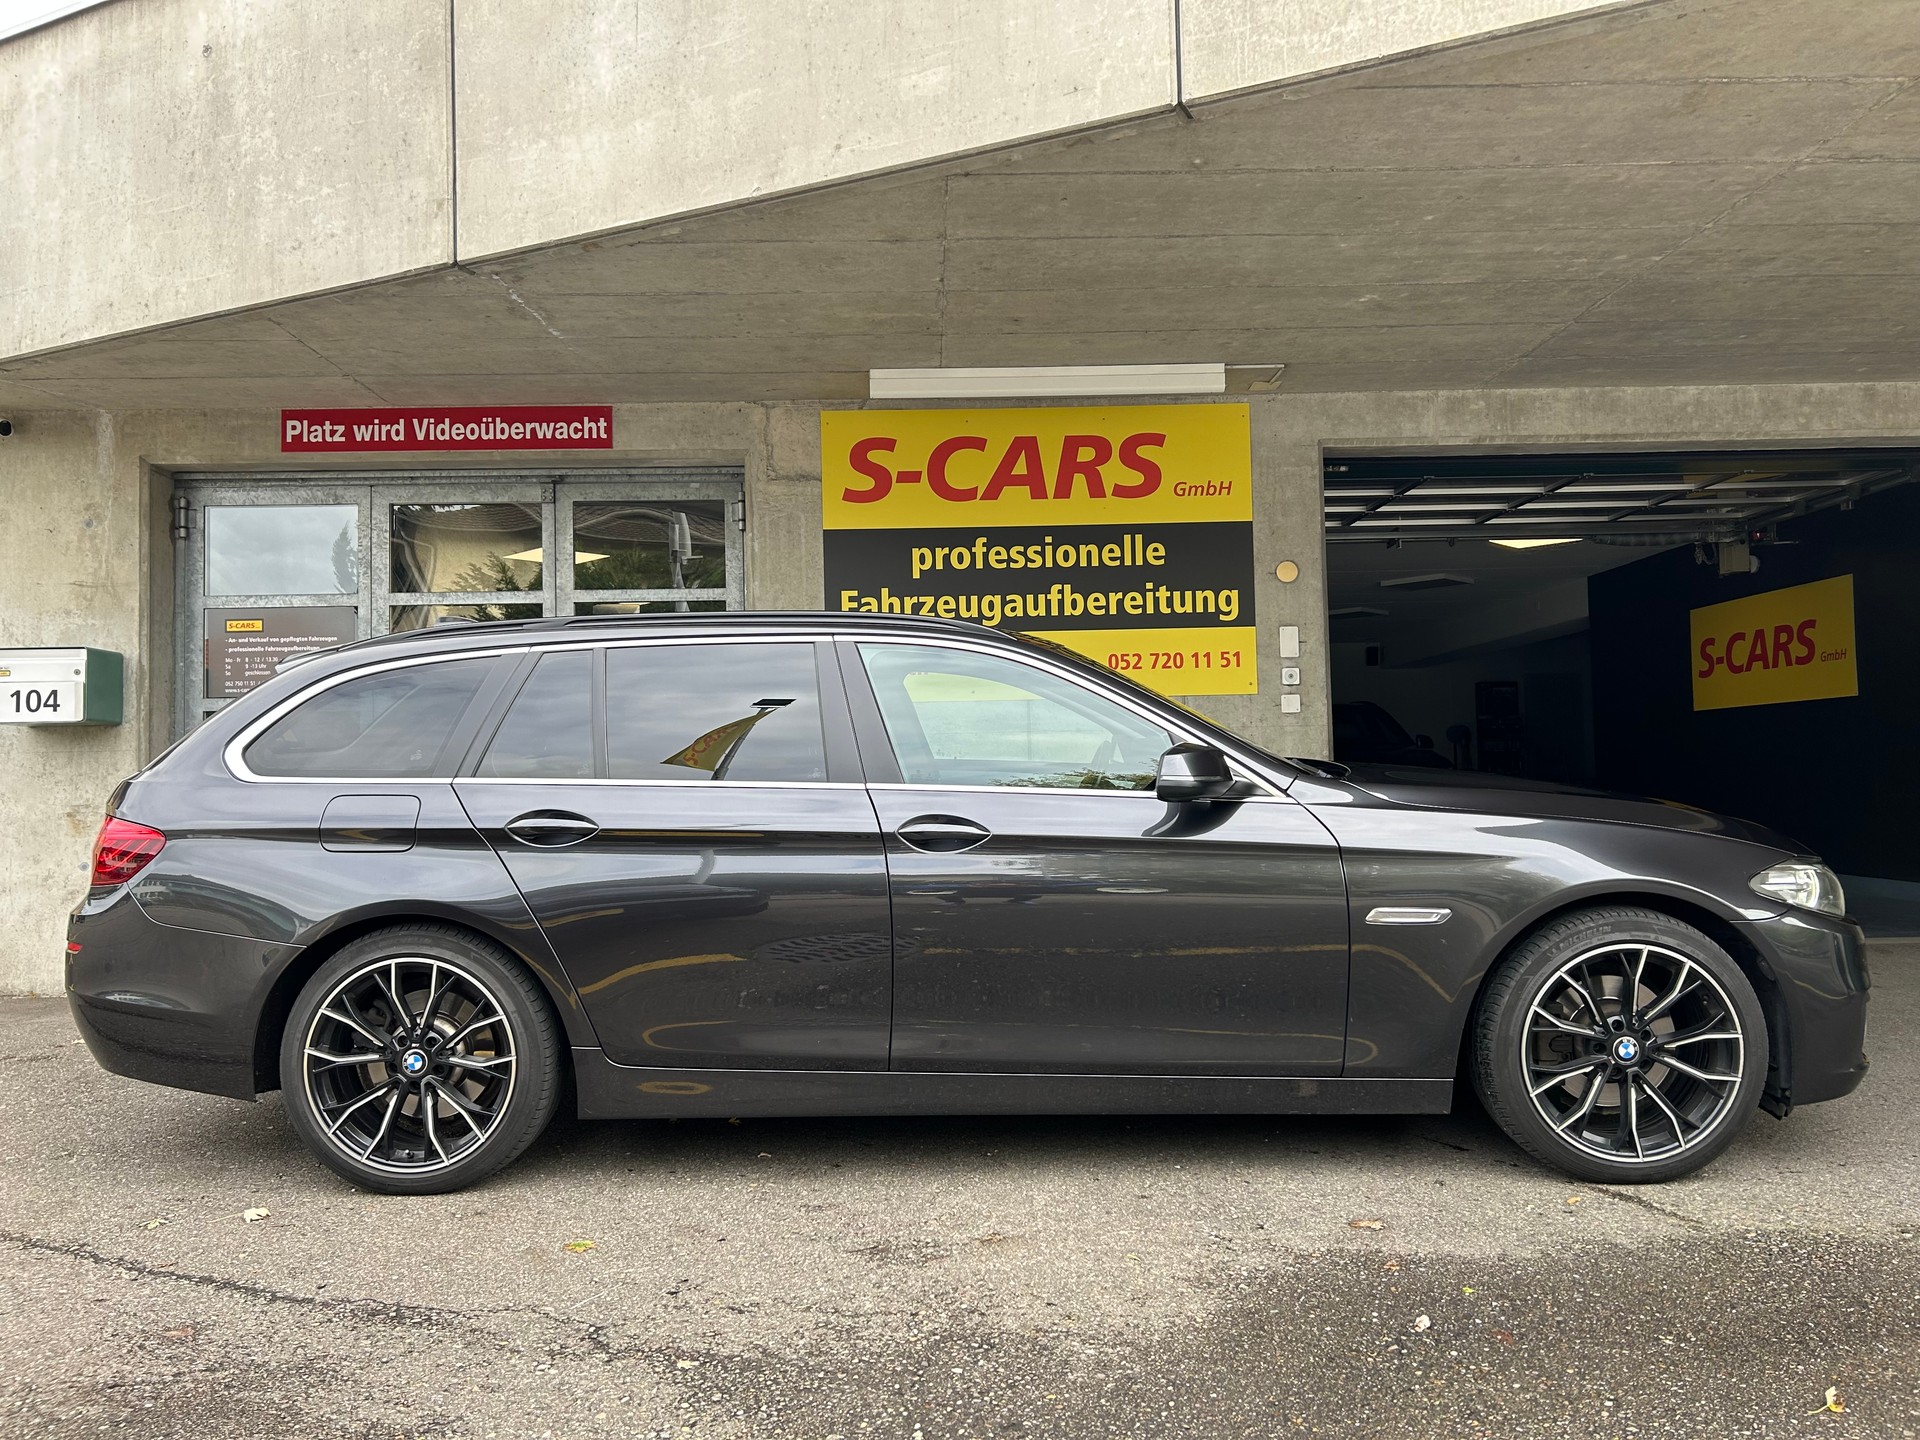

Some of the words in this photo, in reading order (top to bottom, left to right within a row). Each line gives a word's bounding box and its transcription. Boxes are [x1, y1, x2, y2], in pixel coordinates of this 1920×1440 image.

[285, 419, 346, 443] Platz
[353, 418, 405, 442] wird
[412, 416, 608, 441] Videoüberwacht
[841, 432, 1167, 504] S-CARS
[1173, 479, 1233, 499] GmbH
[911, 533, 1166, 579] professionelle
[840, 582, 1241, 627] Fahrzeugaufbereitung
[1107, 652, 1143, 671] 052
[1149, 651, 1184, 670] 720
[1191, 651, 1212, 670] 11
[1220, 650, 1242, 669] 51
[1698, 619, 1817, 679] S-CARS
[1820, 648, 1848, 663] GmbH
[9, 689, 61, 713] 104
[1558, 925, 1612, 950] MICHELIN
